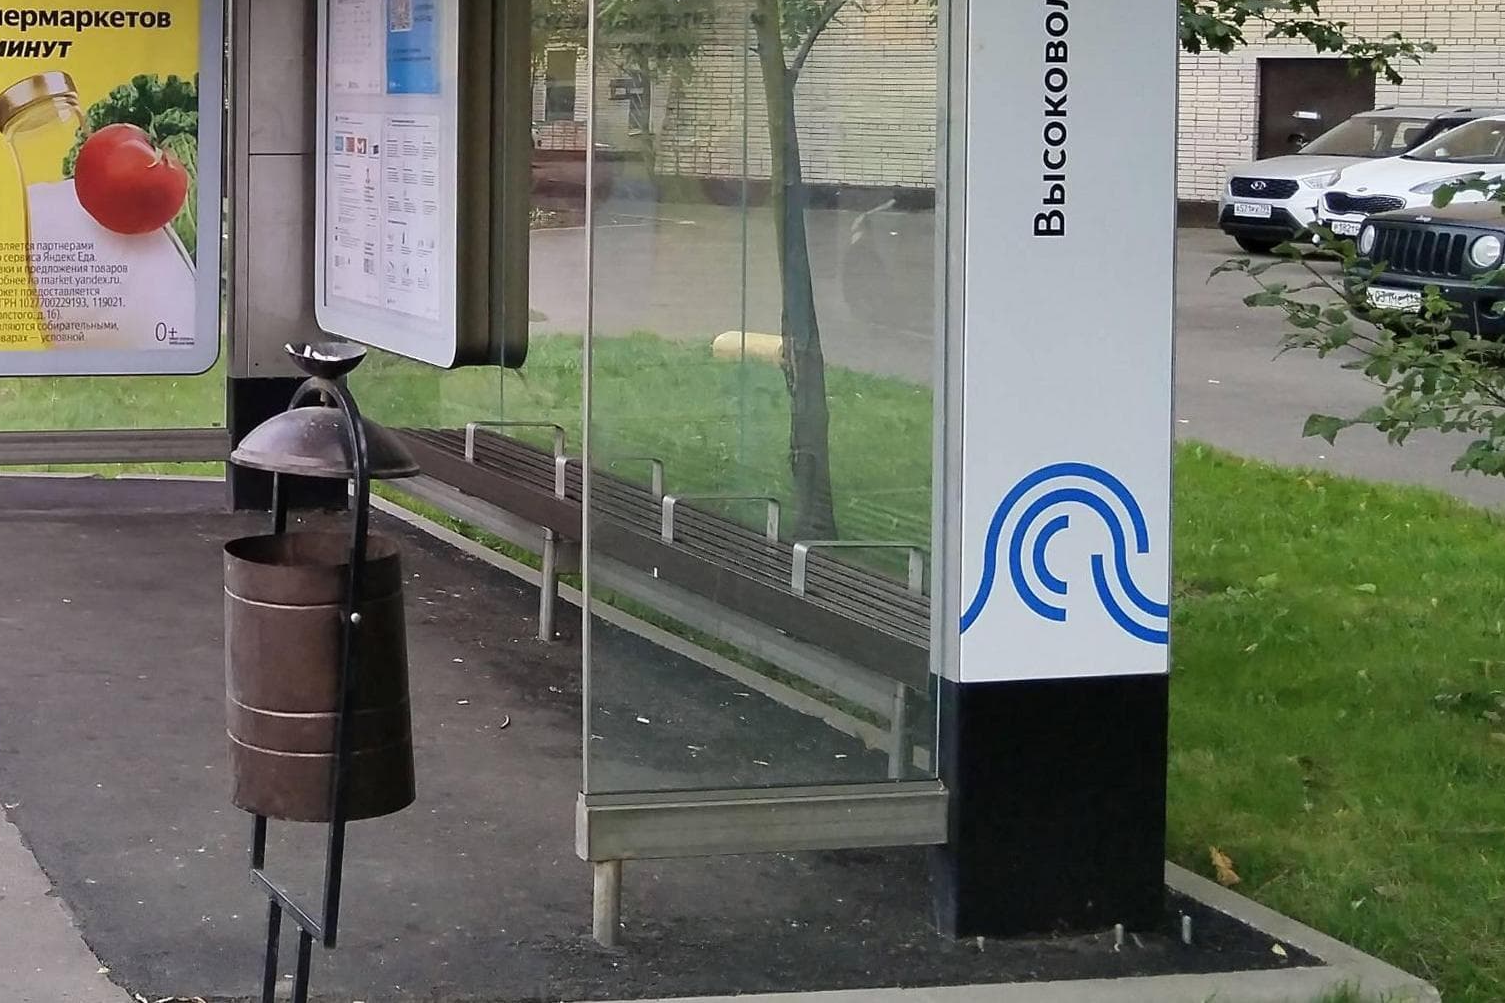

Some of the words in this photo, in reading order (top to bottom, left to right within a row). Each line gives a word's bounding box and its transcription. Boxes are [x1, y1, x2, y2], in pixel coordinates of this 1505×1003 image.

[37, 241, 94, 252] партнерами
[43, 251, 76, 262] Яндекс
[91, 265, 128, 274] товаров
[20, 288, 100, 298] предоставляется
[155, 322, 177, 341] 0+
